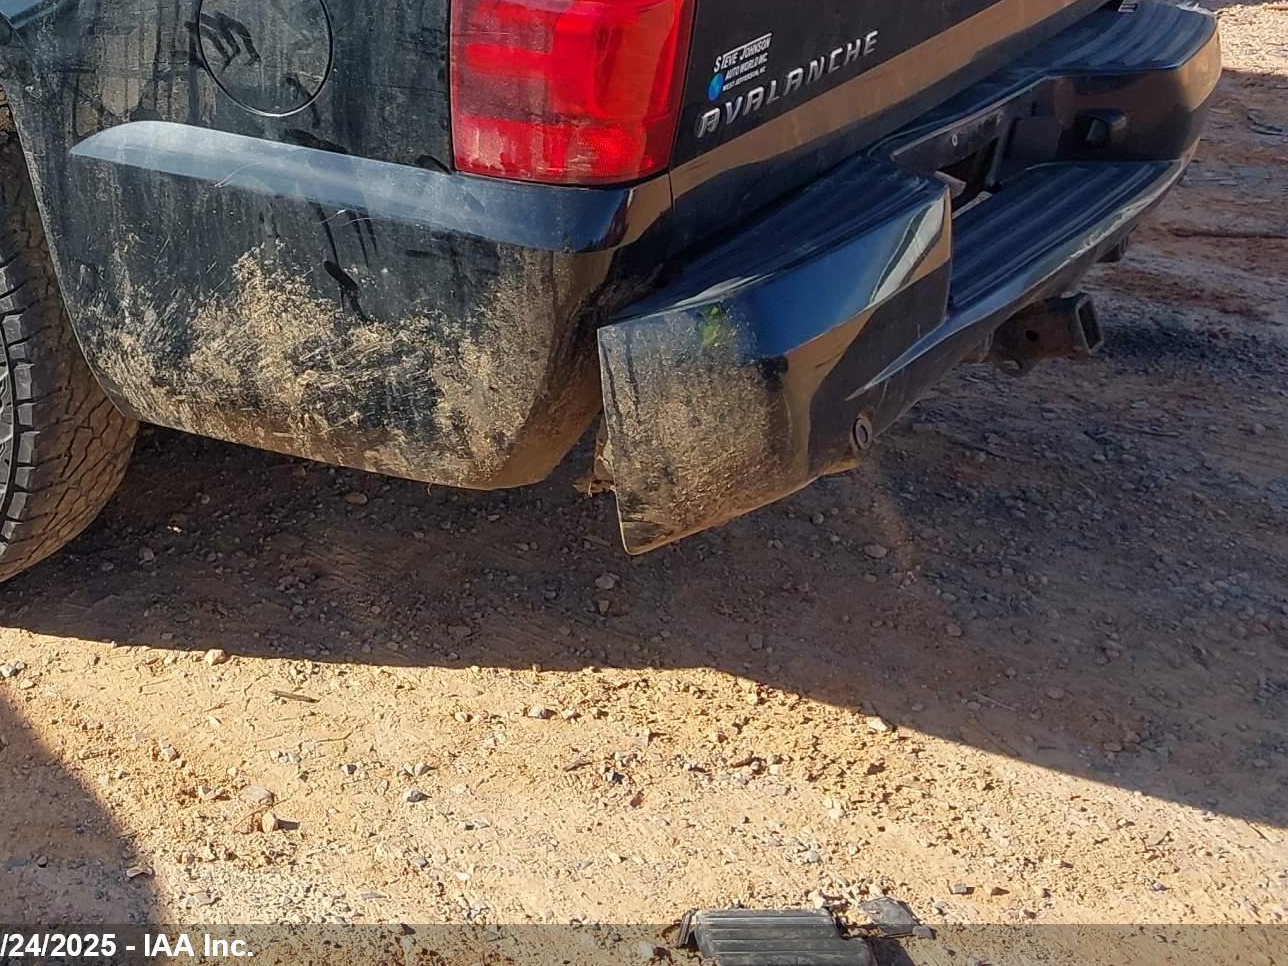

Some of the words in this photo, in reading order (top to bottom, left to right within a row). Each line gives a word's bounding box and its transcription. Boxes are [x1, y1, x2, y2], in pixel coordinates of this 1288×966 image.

[695, 30, 879, 138] AVALANCHE
[714, 52, 739, 73] STEVE
[739, 37, 771, 61] JOHNSON
